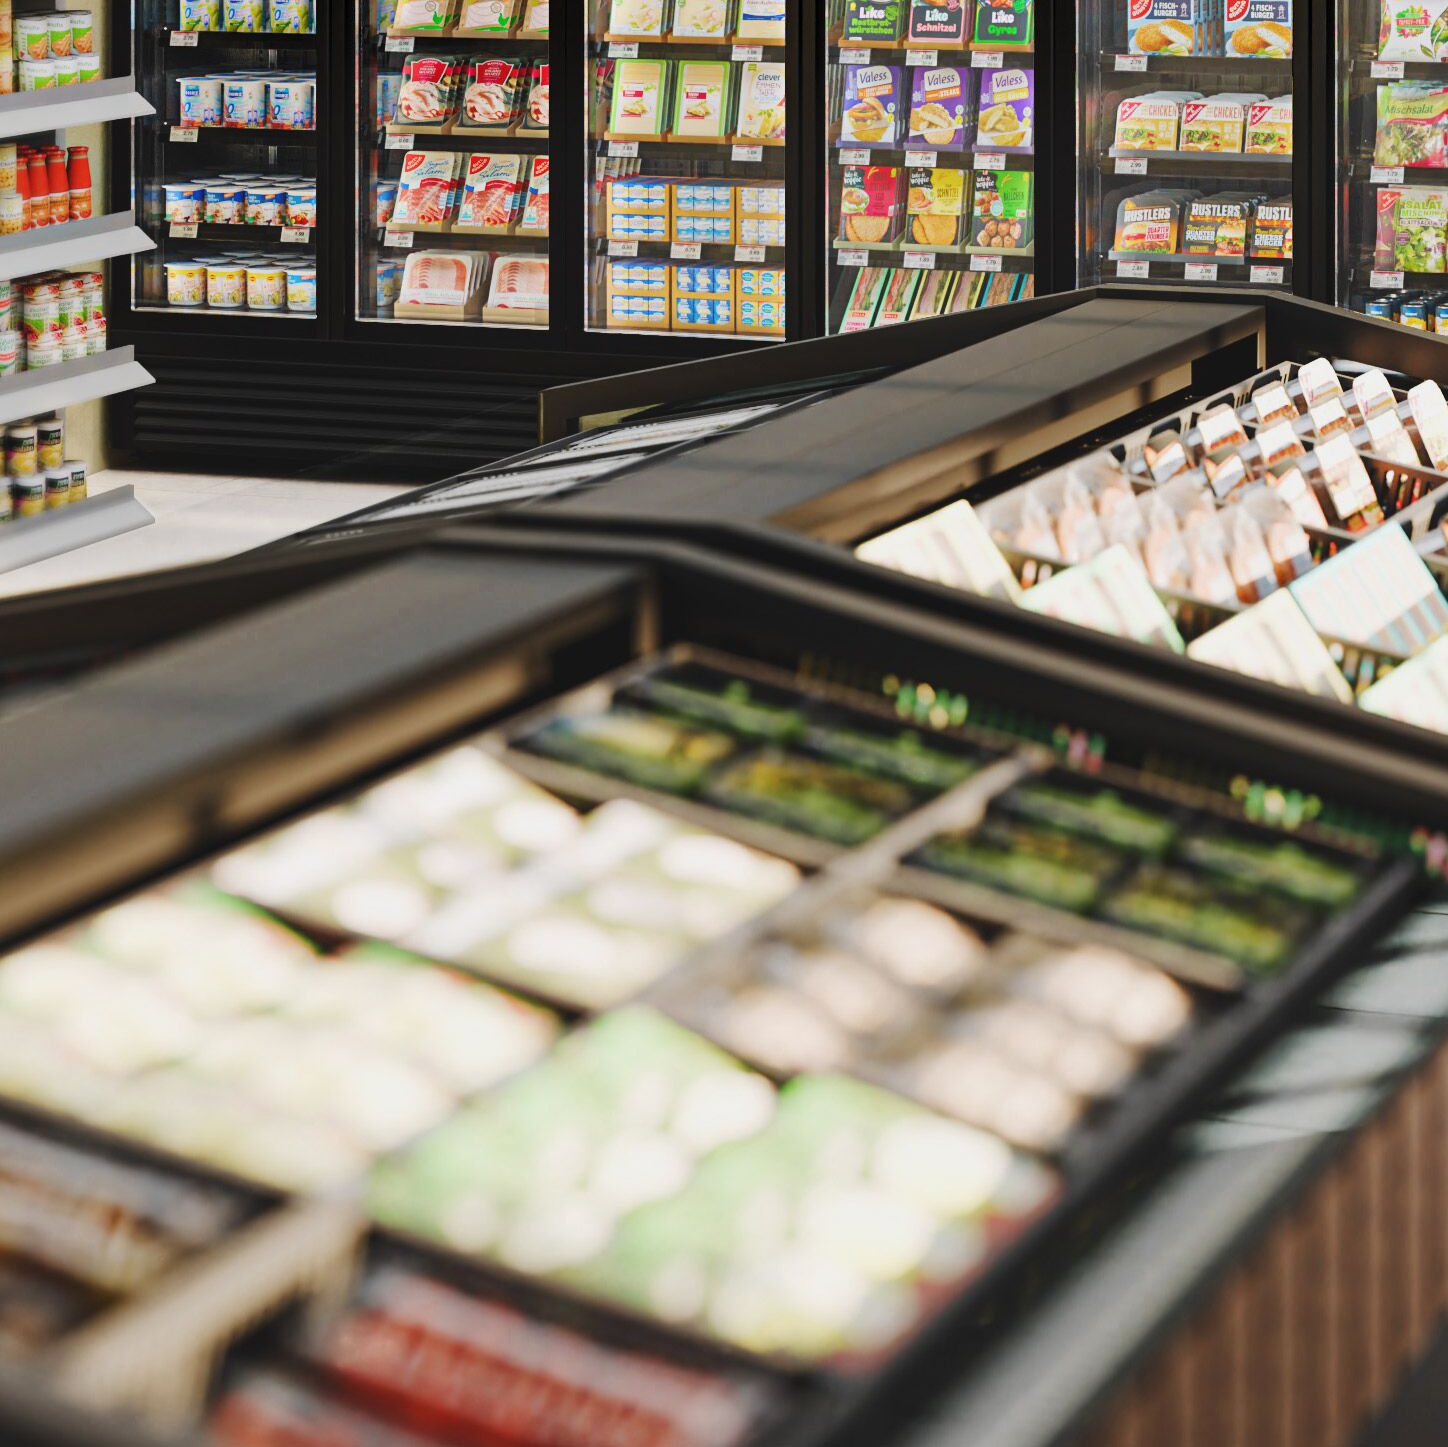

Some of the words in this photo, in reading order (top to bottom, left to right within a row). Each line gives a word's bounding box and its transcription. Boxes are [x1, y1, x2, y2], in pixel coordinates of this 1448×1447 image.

[859, 5, 885, 19] Like
[1153, 9, 1177, 17] BURGER
[1159, 2, 1179, 11] FISCH-
[1256, 3, 1276, 12] FISCH-
[925, 8, 949, 22] Like
[991, 10, 1015, 24] Like
[1250, 11, 1274, 19] BURGER
[916, 22, 957, 33] Schnitzel
[987, 24, 1017, 36] Gyros
[757, 72, 781, 81] clever
[859, 70, 888, 84] Valess
[927, 72, 956, 86] Valess
[995, 74, 1023, 88] Valess
[1148, 104, 1177, 118] CHICKEN
[1213, 105, 1242, 119] CHICKEN
[1385, 104, 1433, 114] Mischsalat
[1124, 207, 1171, 222] RUSTLERS
[1191, 203, 1241, 217] RUSTLERS
[1257, 205, 1292, 220] RUSTL
